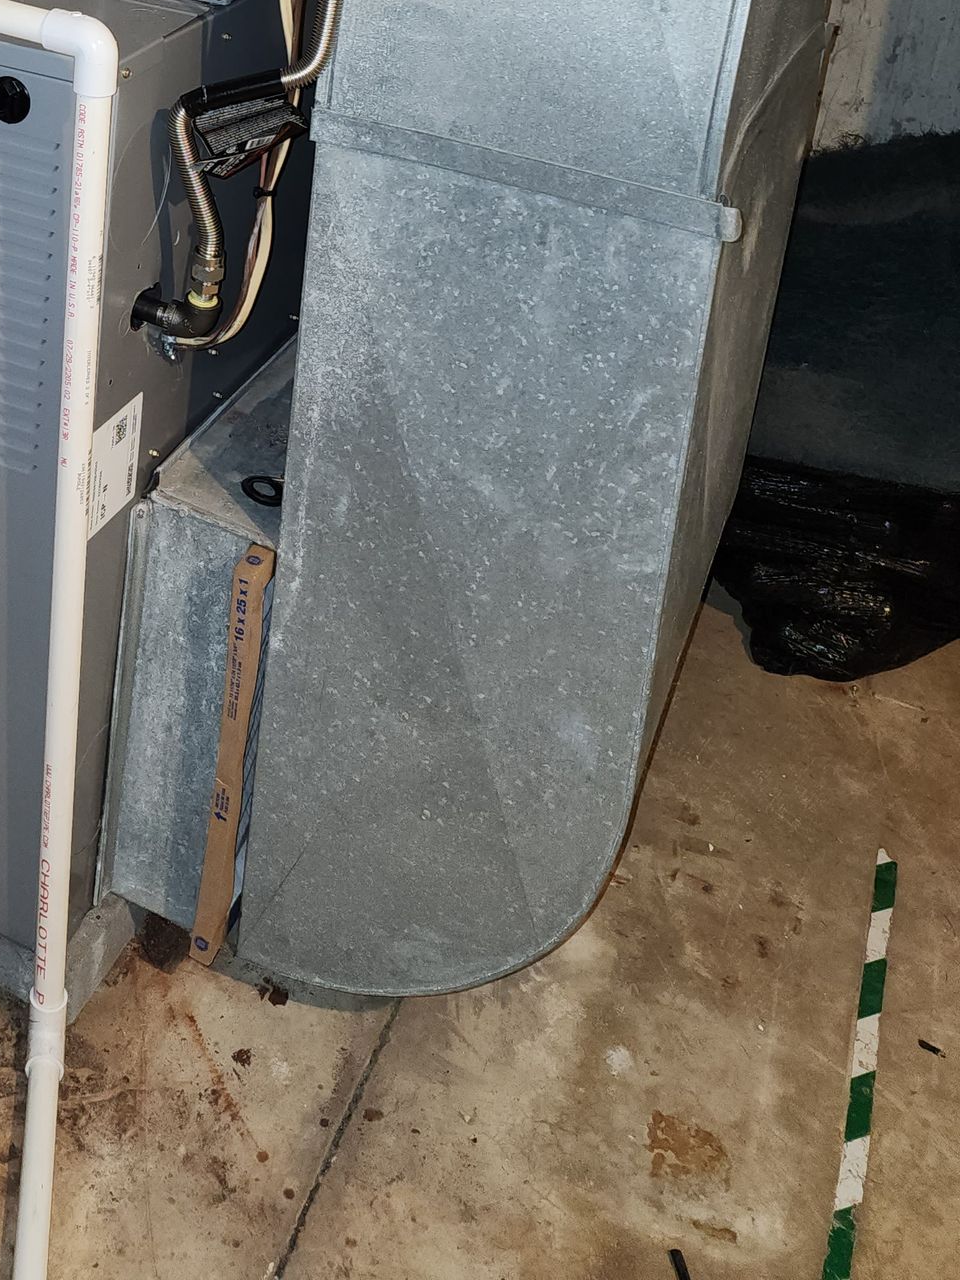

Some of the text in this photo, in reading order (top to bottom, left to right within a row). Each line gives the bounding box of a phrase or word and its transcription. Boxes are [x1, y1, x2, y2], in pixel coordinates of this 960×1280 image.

[77, 127, 85, 148] ASTM
[69, 255, 77, 276] MADE
[69, 280, 77, 290] IN
[239, 588, 248, 597] x
[236, 598, 246, 615] 25
[237, 617, 245, 625] x
[234, 626, 245, 641] 16
[35, 858, 51, 1006] CHARLOTTE P
